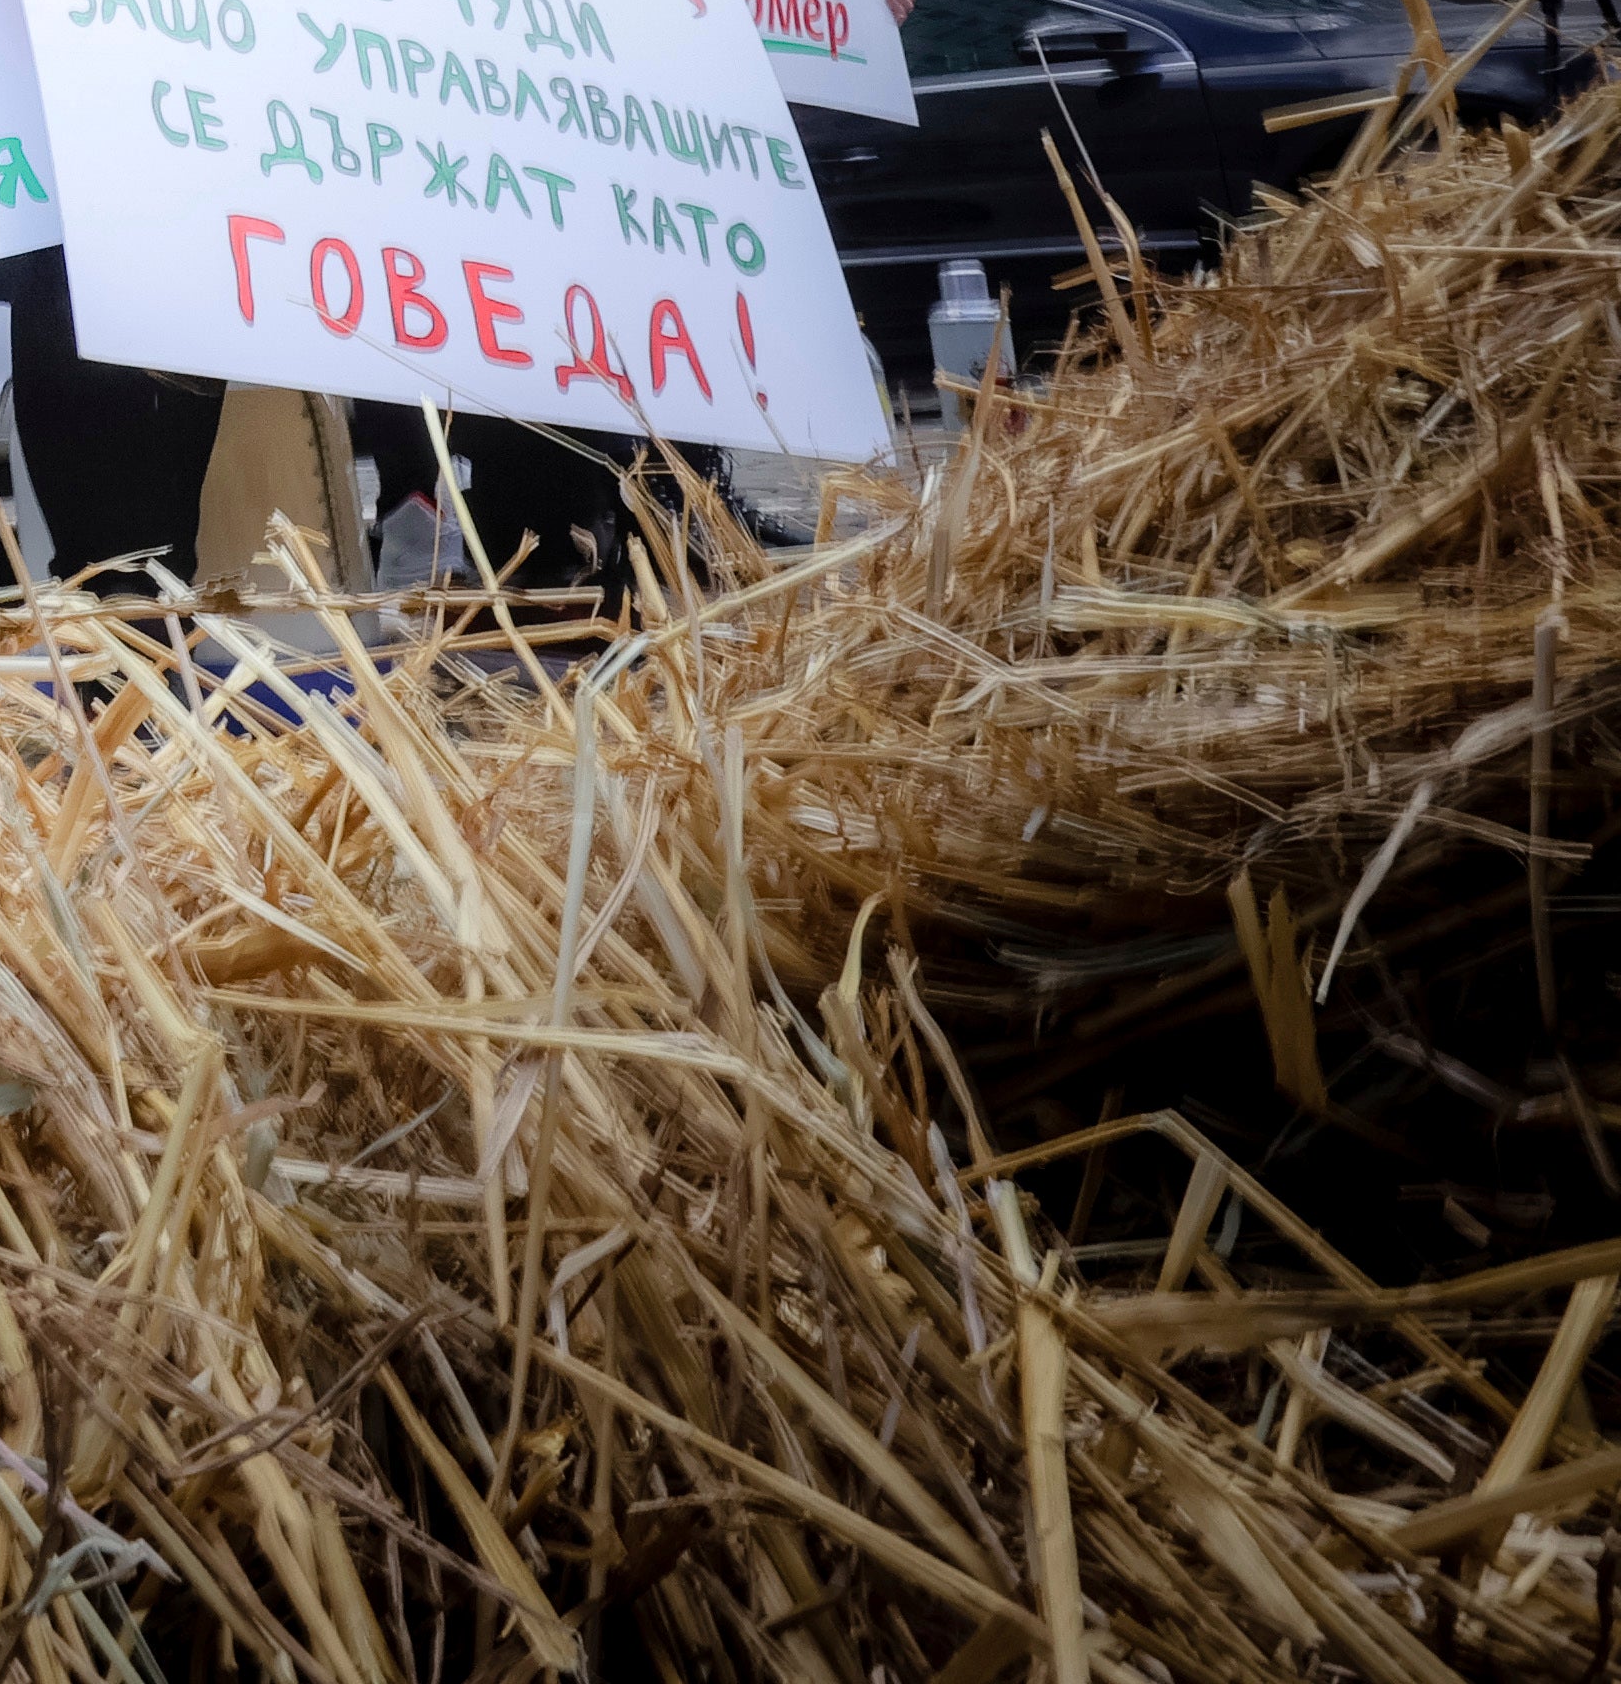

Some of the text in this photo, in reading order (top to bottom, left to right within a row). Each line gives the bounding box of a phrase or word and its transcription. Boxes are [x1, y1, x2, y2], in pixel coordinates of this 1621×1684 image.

[151, 79, 767, 278] СЕ ДЪРЖАТ КАТО
[296, 12, 807, 190] УПРАВЛЯВАЩИТЕ
[227, 213, 770, 412] ГОВЕДА!
